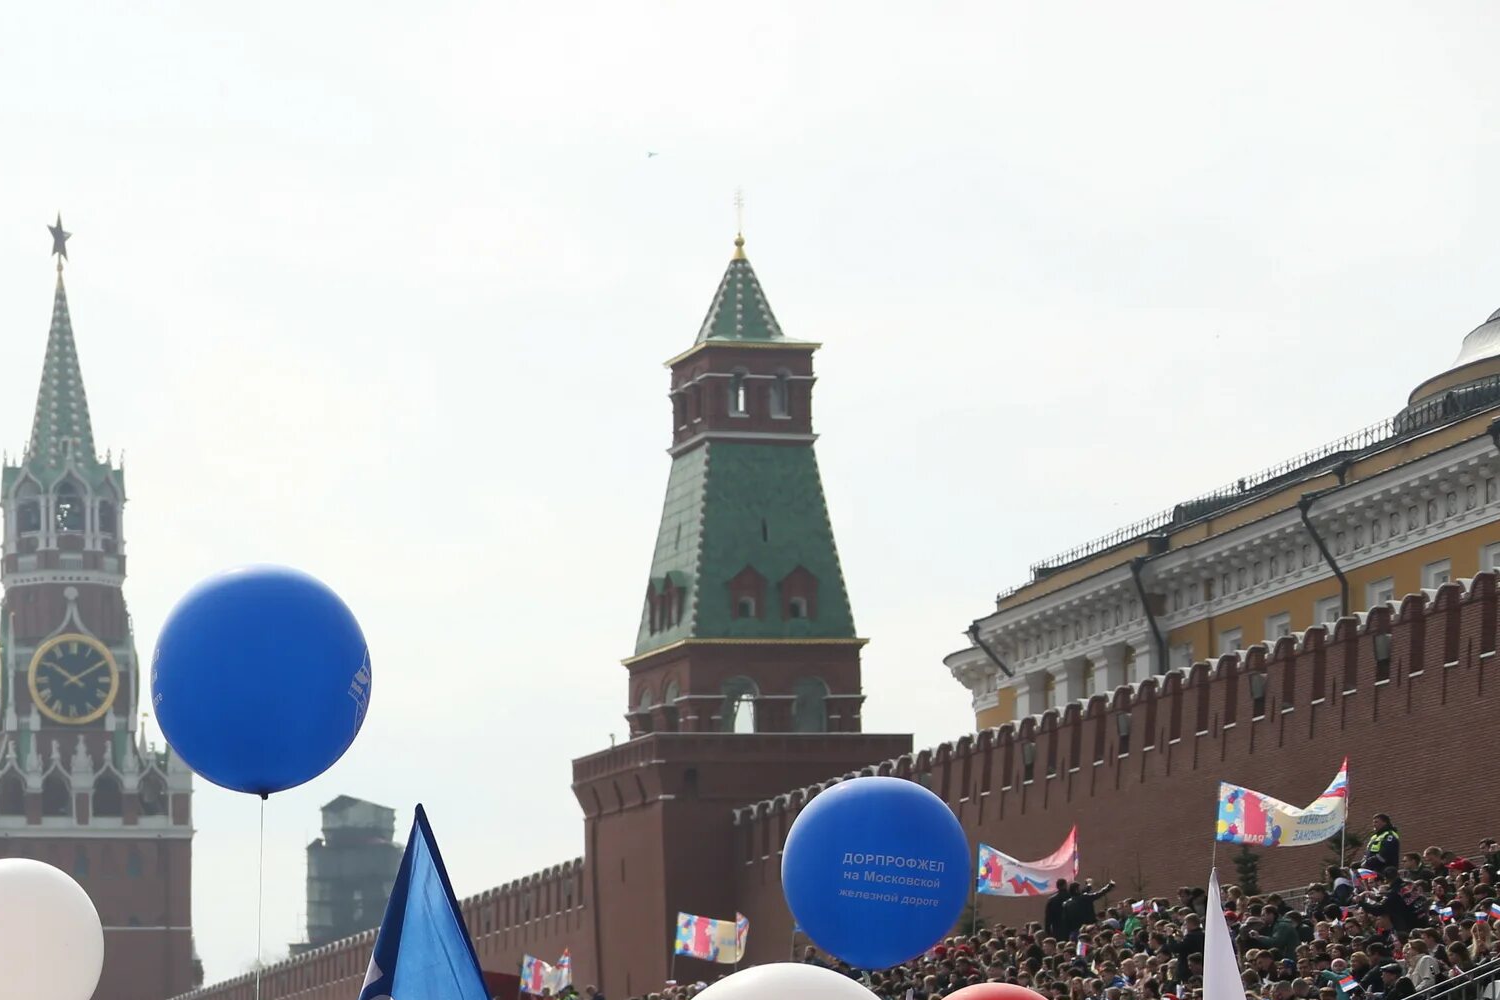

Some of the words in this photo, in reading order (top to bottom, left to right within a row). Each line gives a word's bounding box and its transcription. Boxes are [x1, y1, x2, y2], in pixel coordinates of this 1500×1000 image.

[1243, 834, 1264, 843] МАЯ
[842, 852, 946, 873] ДОРПРОФЖЕЛ
[843, 870, 860, 881] на
[863, 870, 941, 889] Московской
[838, 888, 899, 903] железной
[900, 893, 940, 908] дороге
